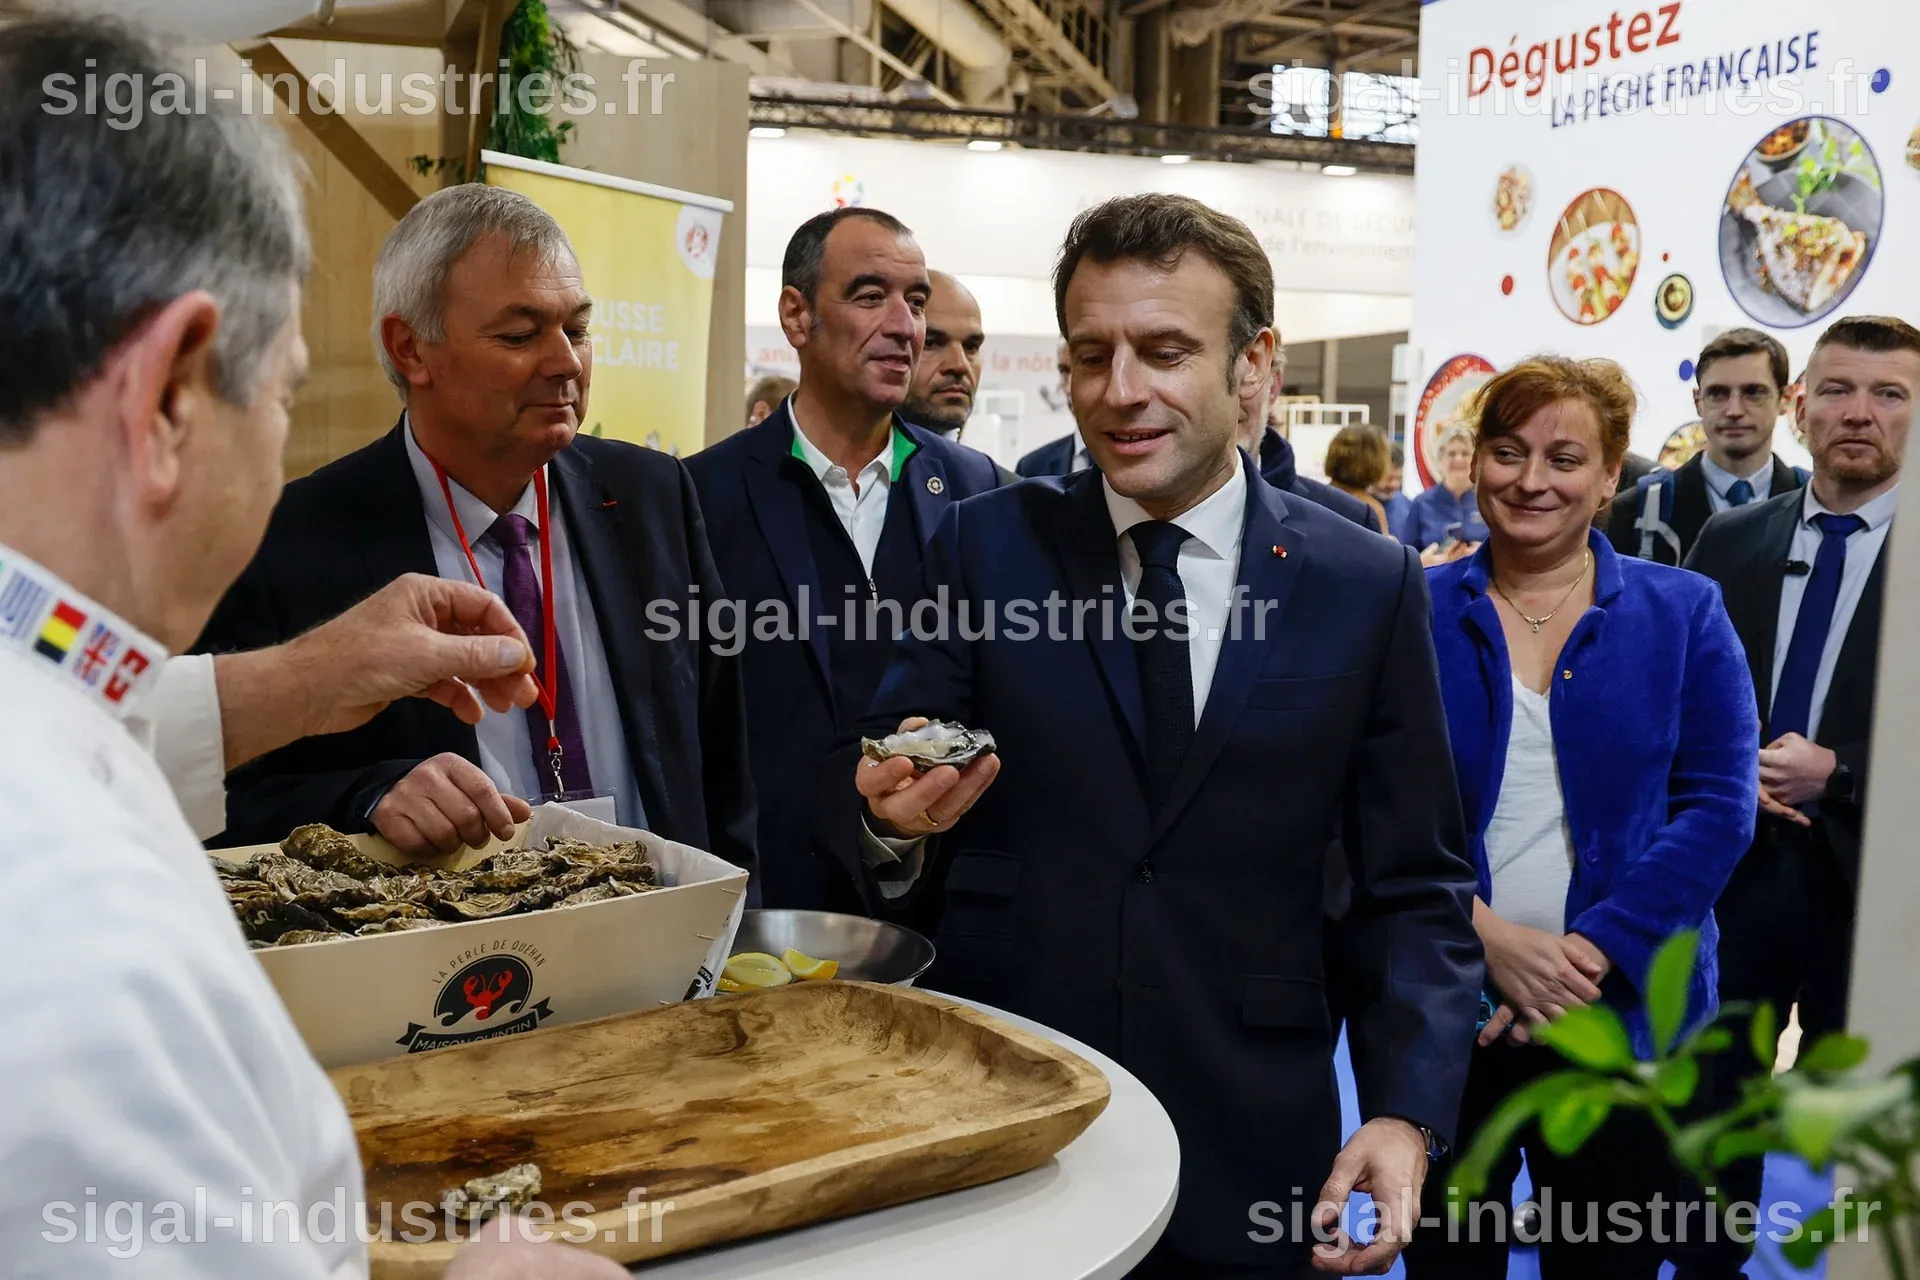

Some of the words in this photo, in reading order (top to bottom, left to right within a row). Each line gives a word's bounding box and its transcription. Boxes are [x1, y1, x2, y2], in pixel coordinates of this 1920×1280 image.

[1468, 1, 1681, 98] Dégustez
[1551, 94, 1575, 128] LA
[1666, 31, 1818, 102] FRANÇAISE
[592, 333, 679, 371] CLAIRE
[432, 970, 448, 984] LA
[450, 943, 487, 968] PERLE
[493, 939, 507, 950] DE
[512, 940, 546, 967] QUÉHAN
